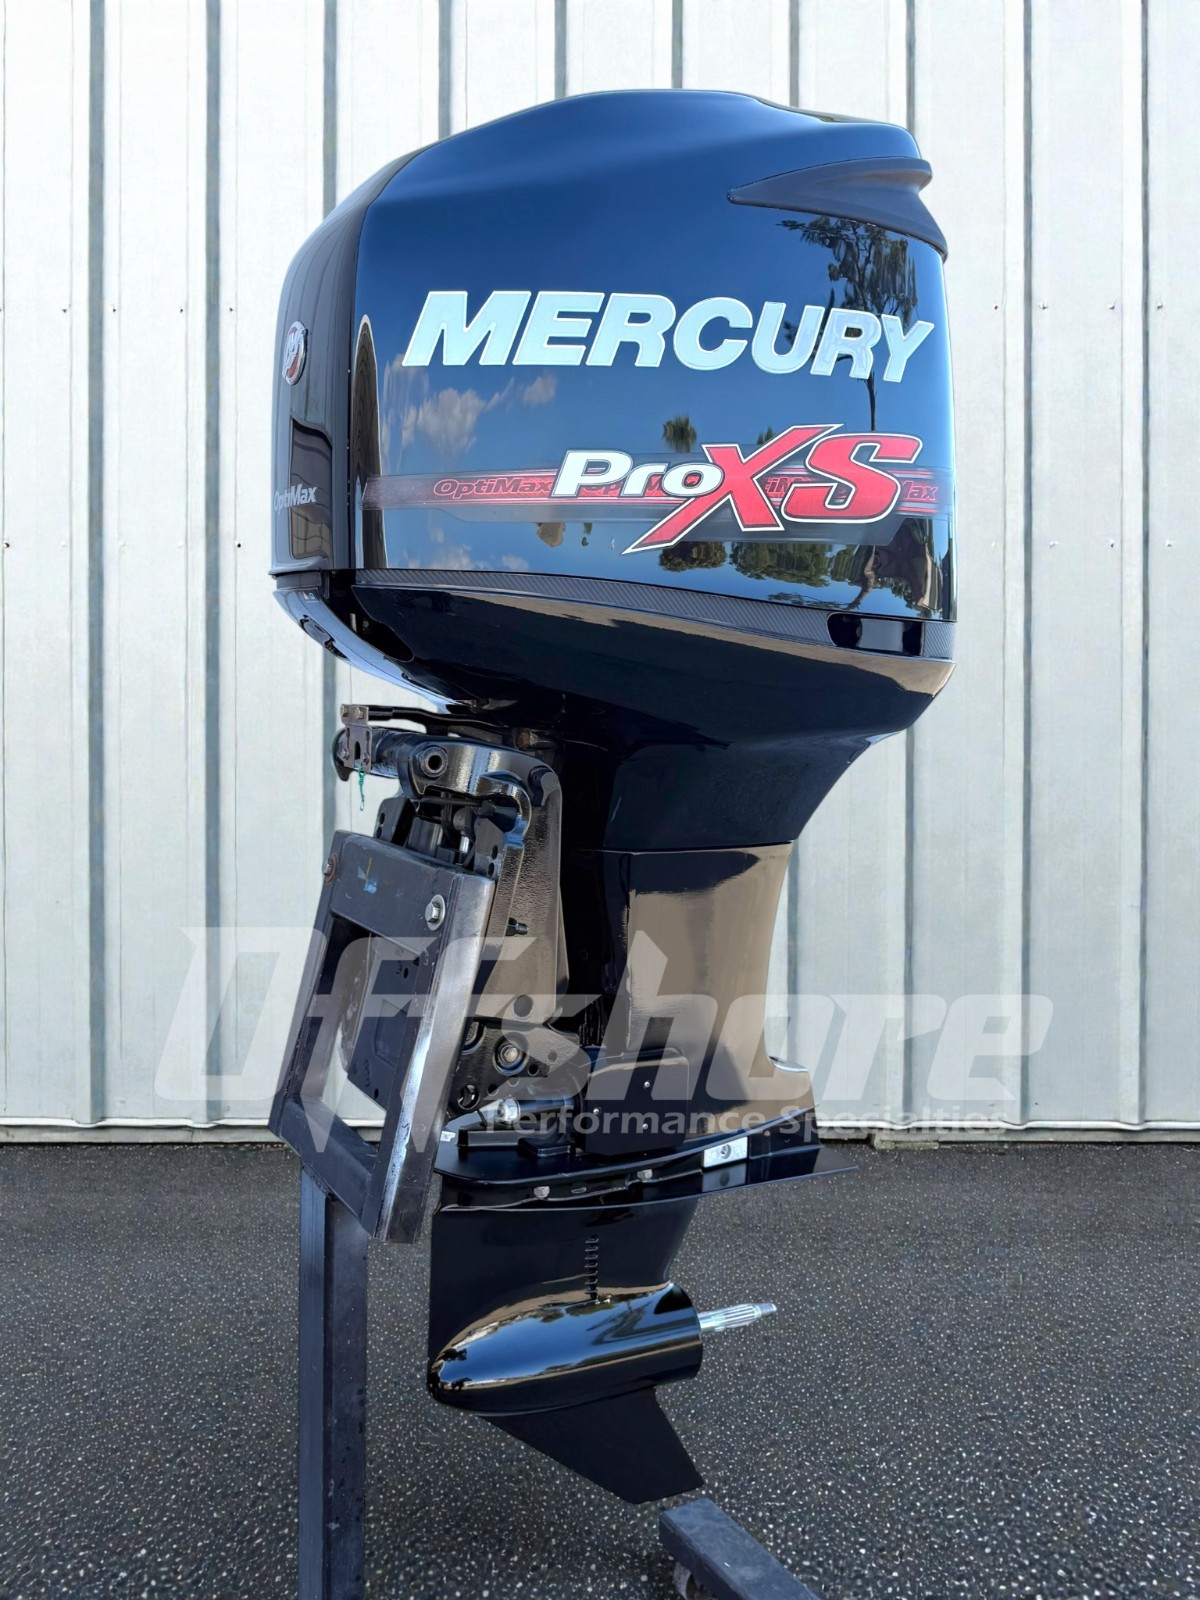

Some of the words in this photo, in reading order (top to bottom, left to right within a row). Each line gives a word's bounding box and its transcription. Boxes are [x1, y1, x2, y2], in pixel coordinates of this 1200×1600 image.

[402, 290, 935, 383] MERCURY
[273, 483, 318, 516] OptiMax
[433, 477, 552, 500] OptiMax
